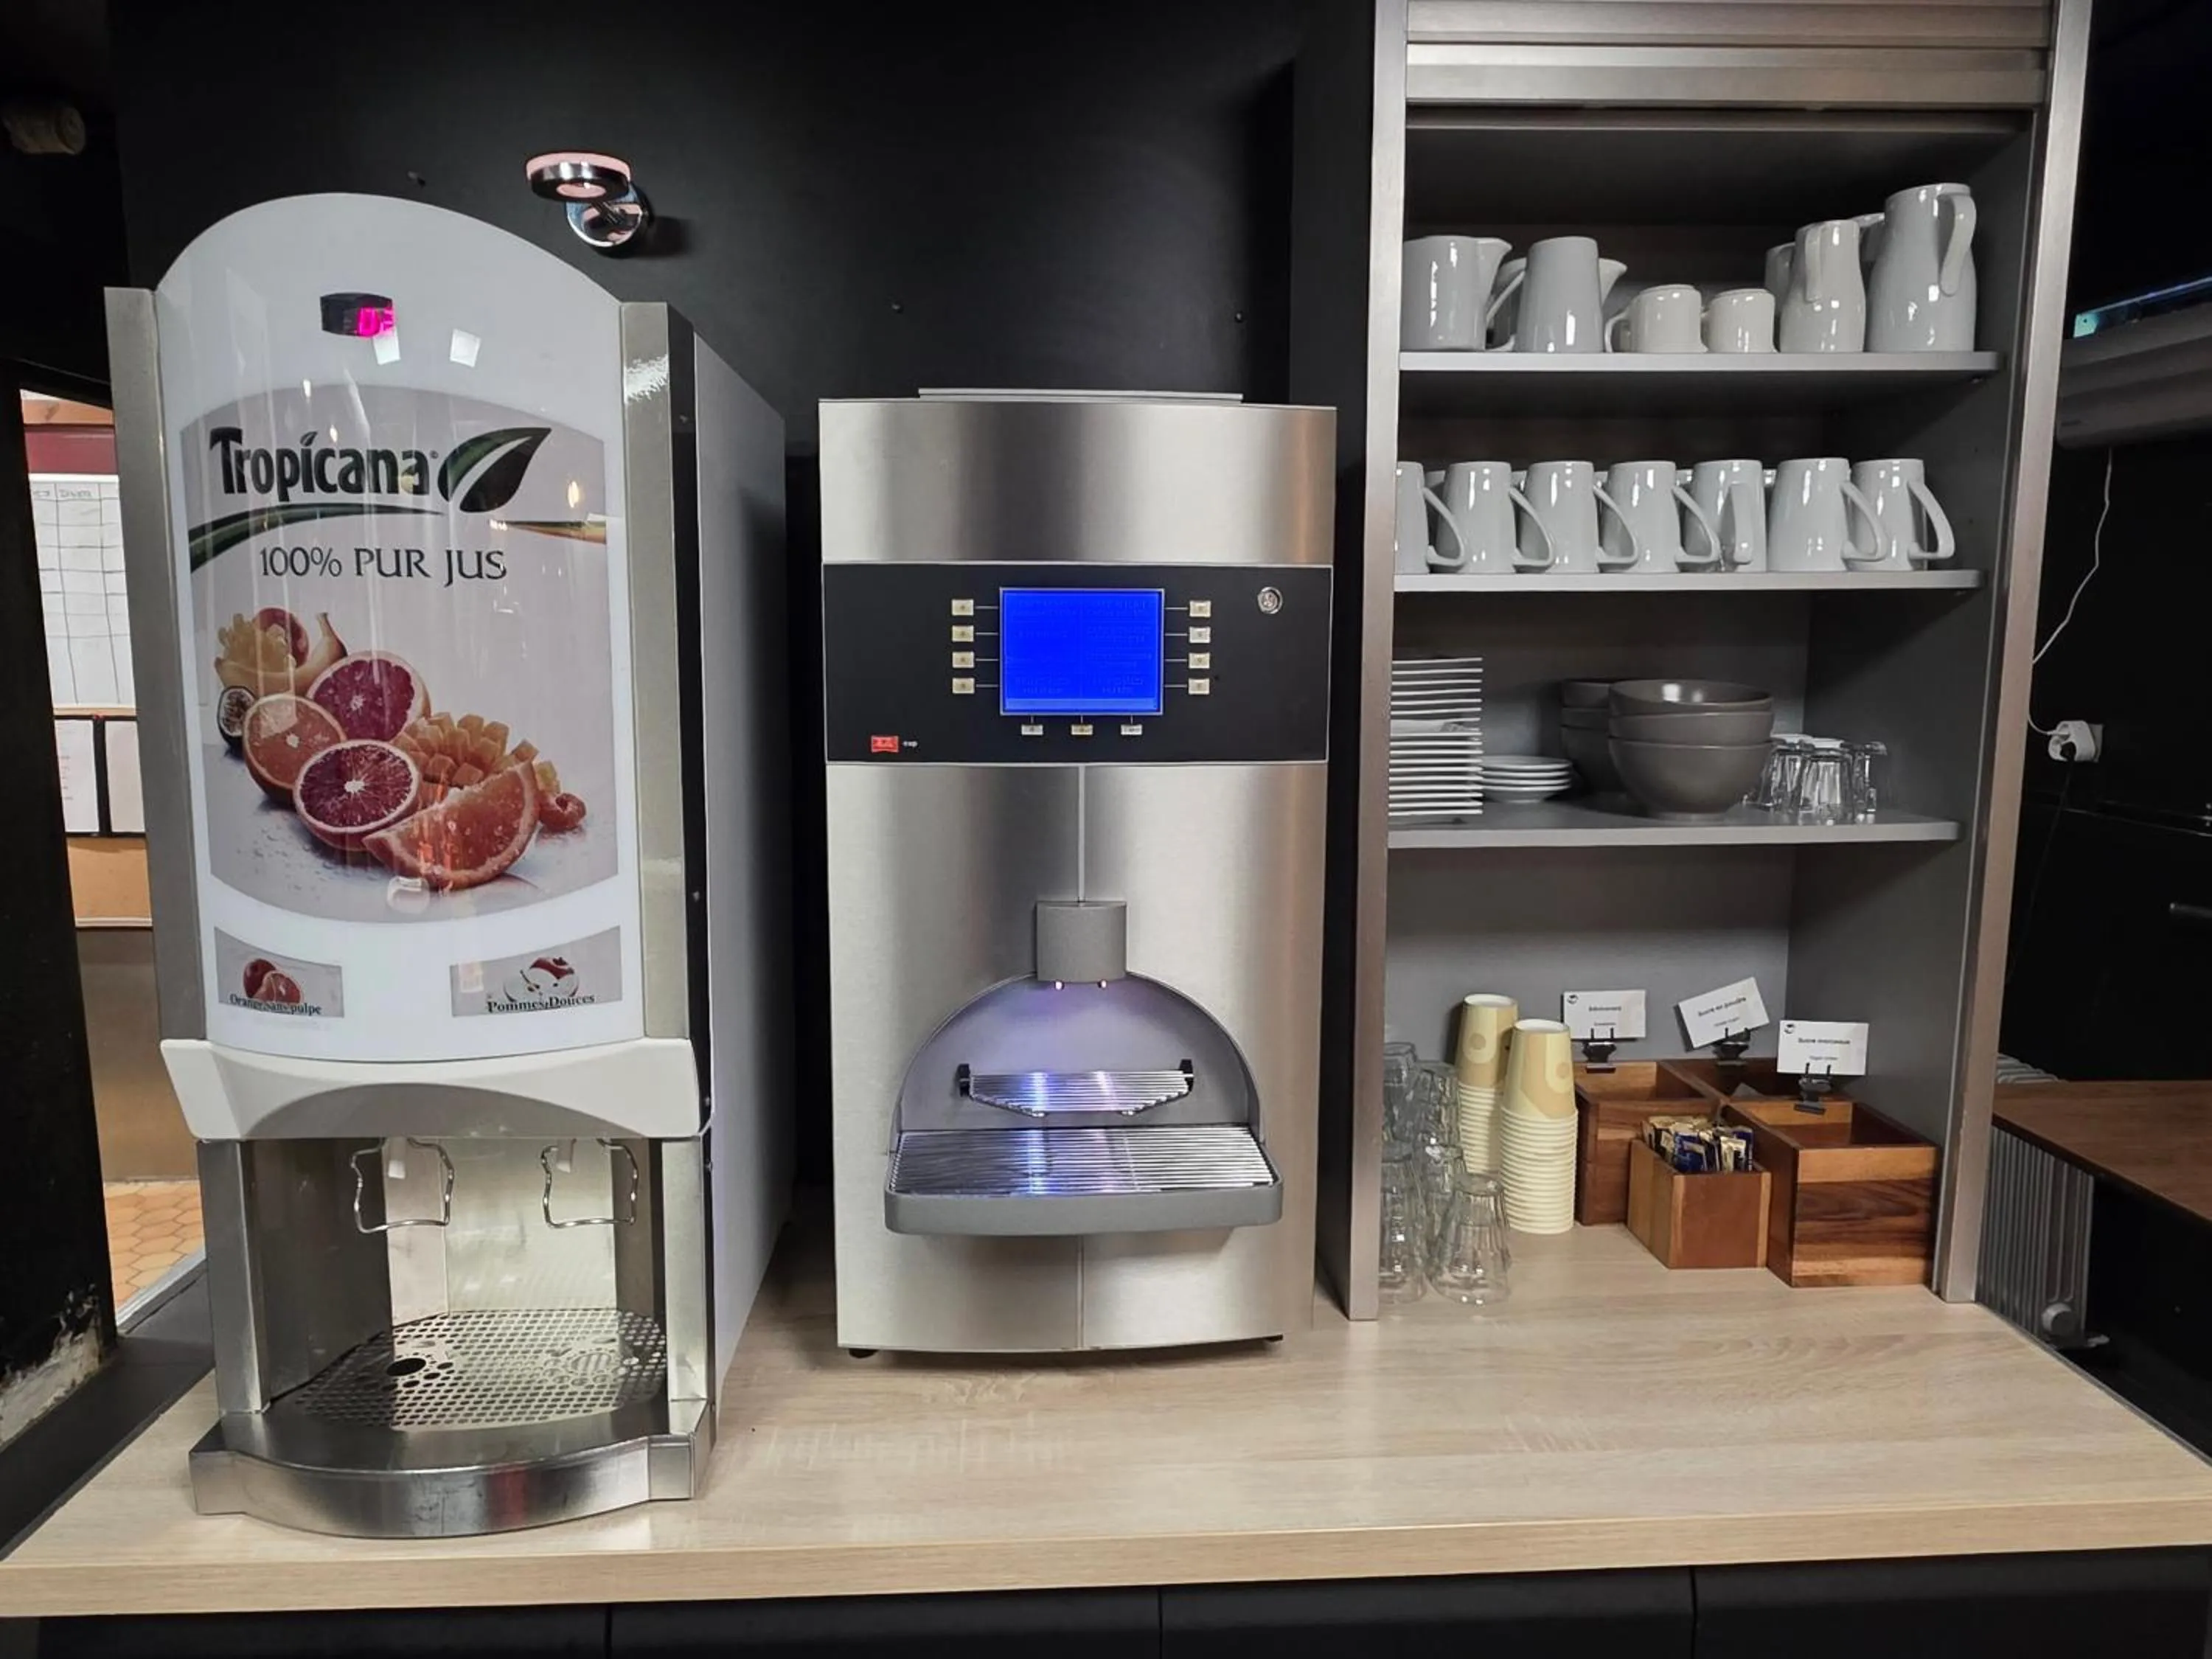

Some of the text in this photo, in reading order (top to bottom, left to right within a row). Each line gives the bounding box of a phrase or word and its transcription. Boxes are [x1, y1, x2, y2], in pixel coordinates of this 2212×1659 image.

[260, 546, 507, 588] 100% PUR JUS
